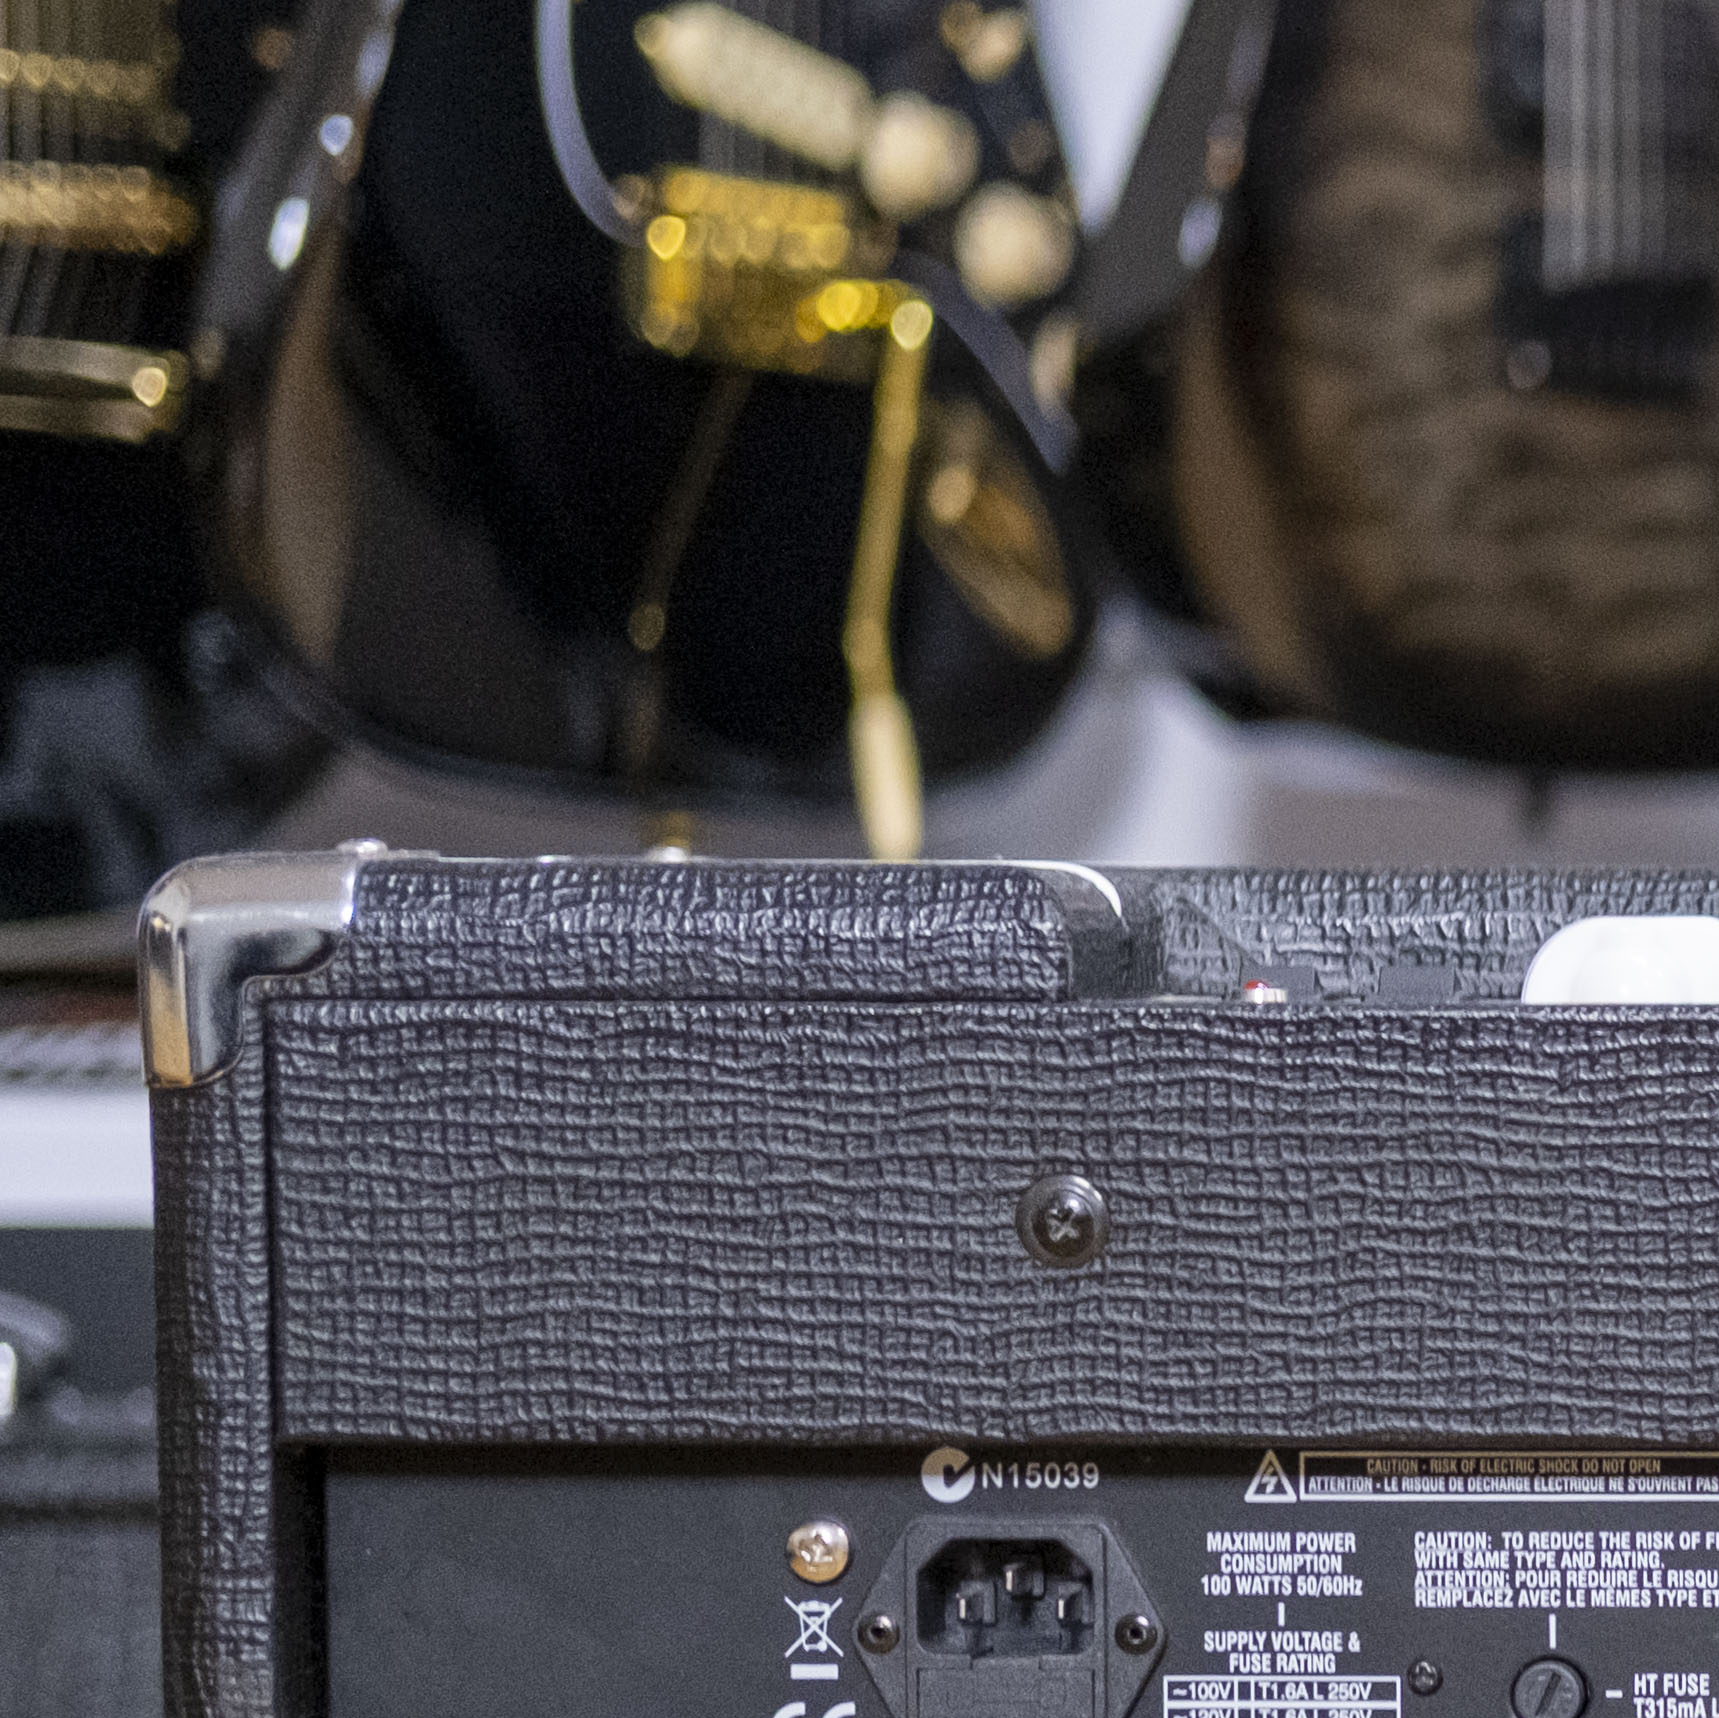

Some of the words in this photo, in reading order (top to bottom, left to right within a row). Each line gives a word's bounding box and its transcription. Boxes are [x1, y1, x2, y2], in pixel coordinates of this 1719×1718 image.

[981, 1463, 1100, 1489] N15039
[1206, 1532, 1291, 1553] MAXIMUM
[1296, 1532, 1357, 1553] POWER
[1414, 1532, 1492, 1550] CAUTION:
[1502, 1532, 1524, 1550] TO
[1528, 1532, 1595, 1550] REDUCE
[1599, 1532, 1631, 1550] THE
[1635, 1532, 1675, 1550] RISK
[1679, 1532, 1701, 1550] OF
[1220, 1554, 1342, 1574] CONSUMPTION
[1414, 1551, 1458, 1569] WITH
[1462, 1551, 1510, 1569] SAME
[1514, 1551, 1556, 1569] TYPE
[1560, 1551, 1596, 1569] AND
[1600, 1551, 1665, 1569] RATING.
[1201, 1575, 1231, 1597] 100
[1235, 1575, 1293, 1597] WATTS
[1296, 1575, 1363, 1597] 50/60Hz
[1203, 1631, 1267, 1652] SUPPLY
[1271, 1631, 1343, 1652] VOLTAGE
[1348, 1631, 1360, 1652] &
[1229, 1653, 1271, 1674] FUSE
[1276, 1653, 1336, 1674] RATING
[1258, 1683, 1309, 1700] T1.6A
[1313, 1683, 1324, 1700] L
[1327, 1683, 1372, 1700] 250V
[1634, 1674, 1658, 1697] HT
[1663, 1674, 1710, 1697] FUSE
